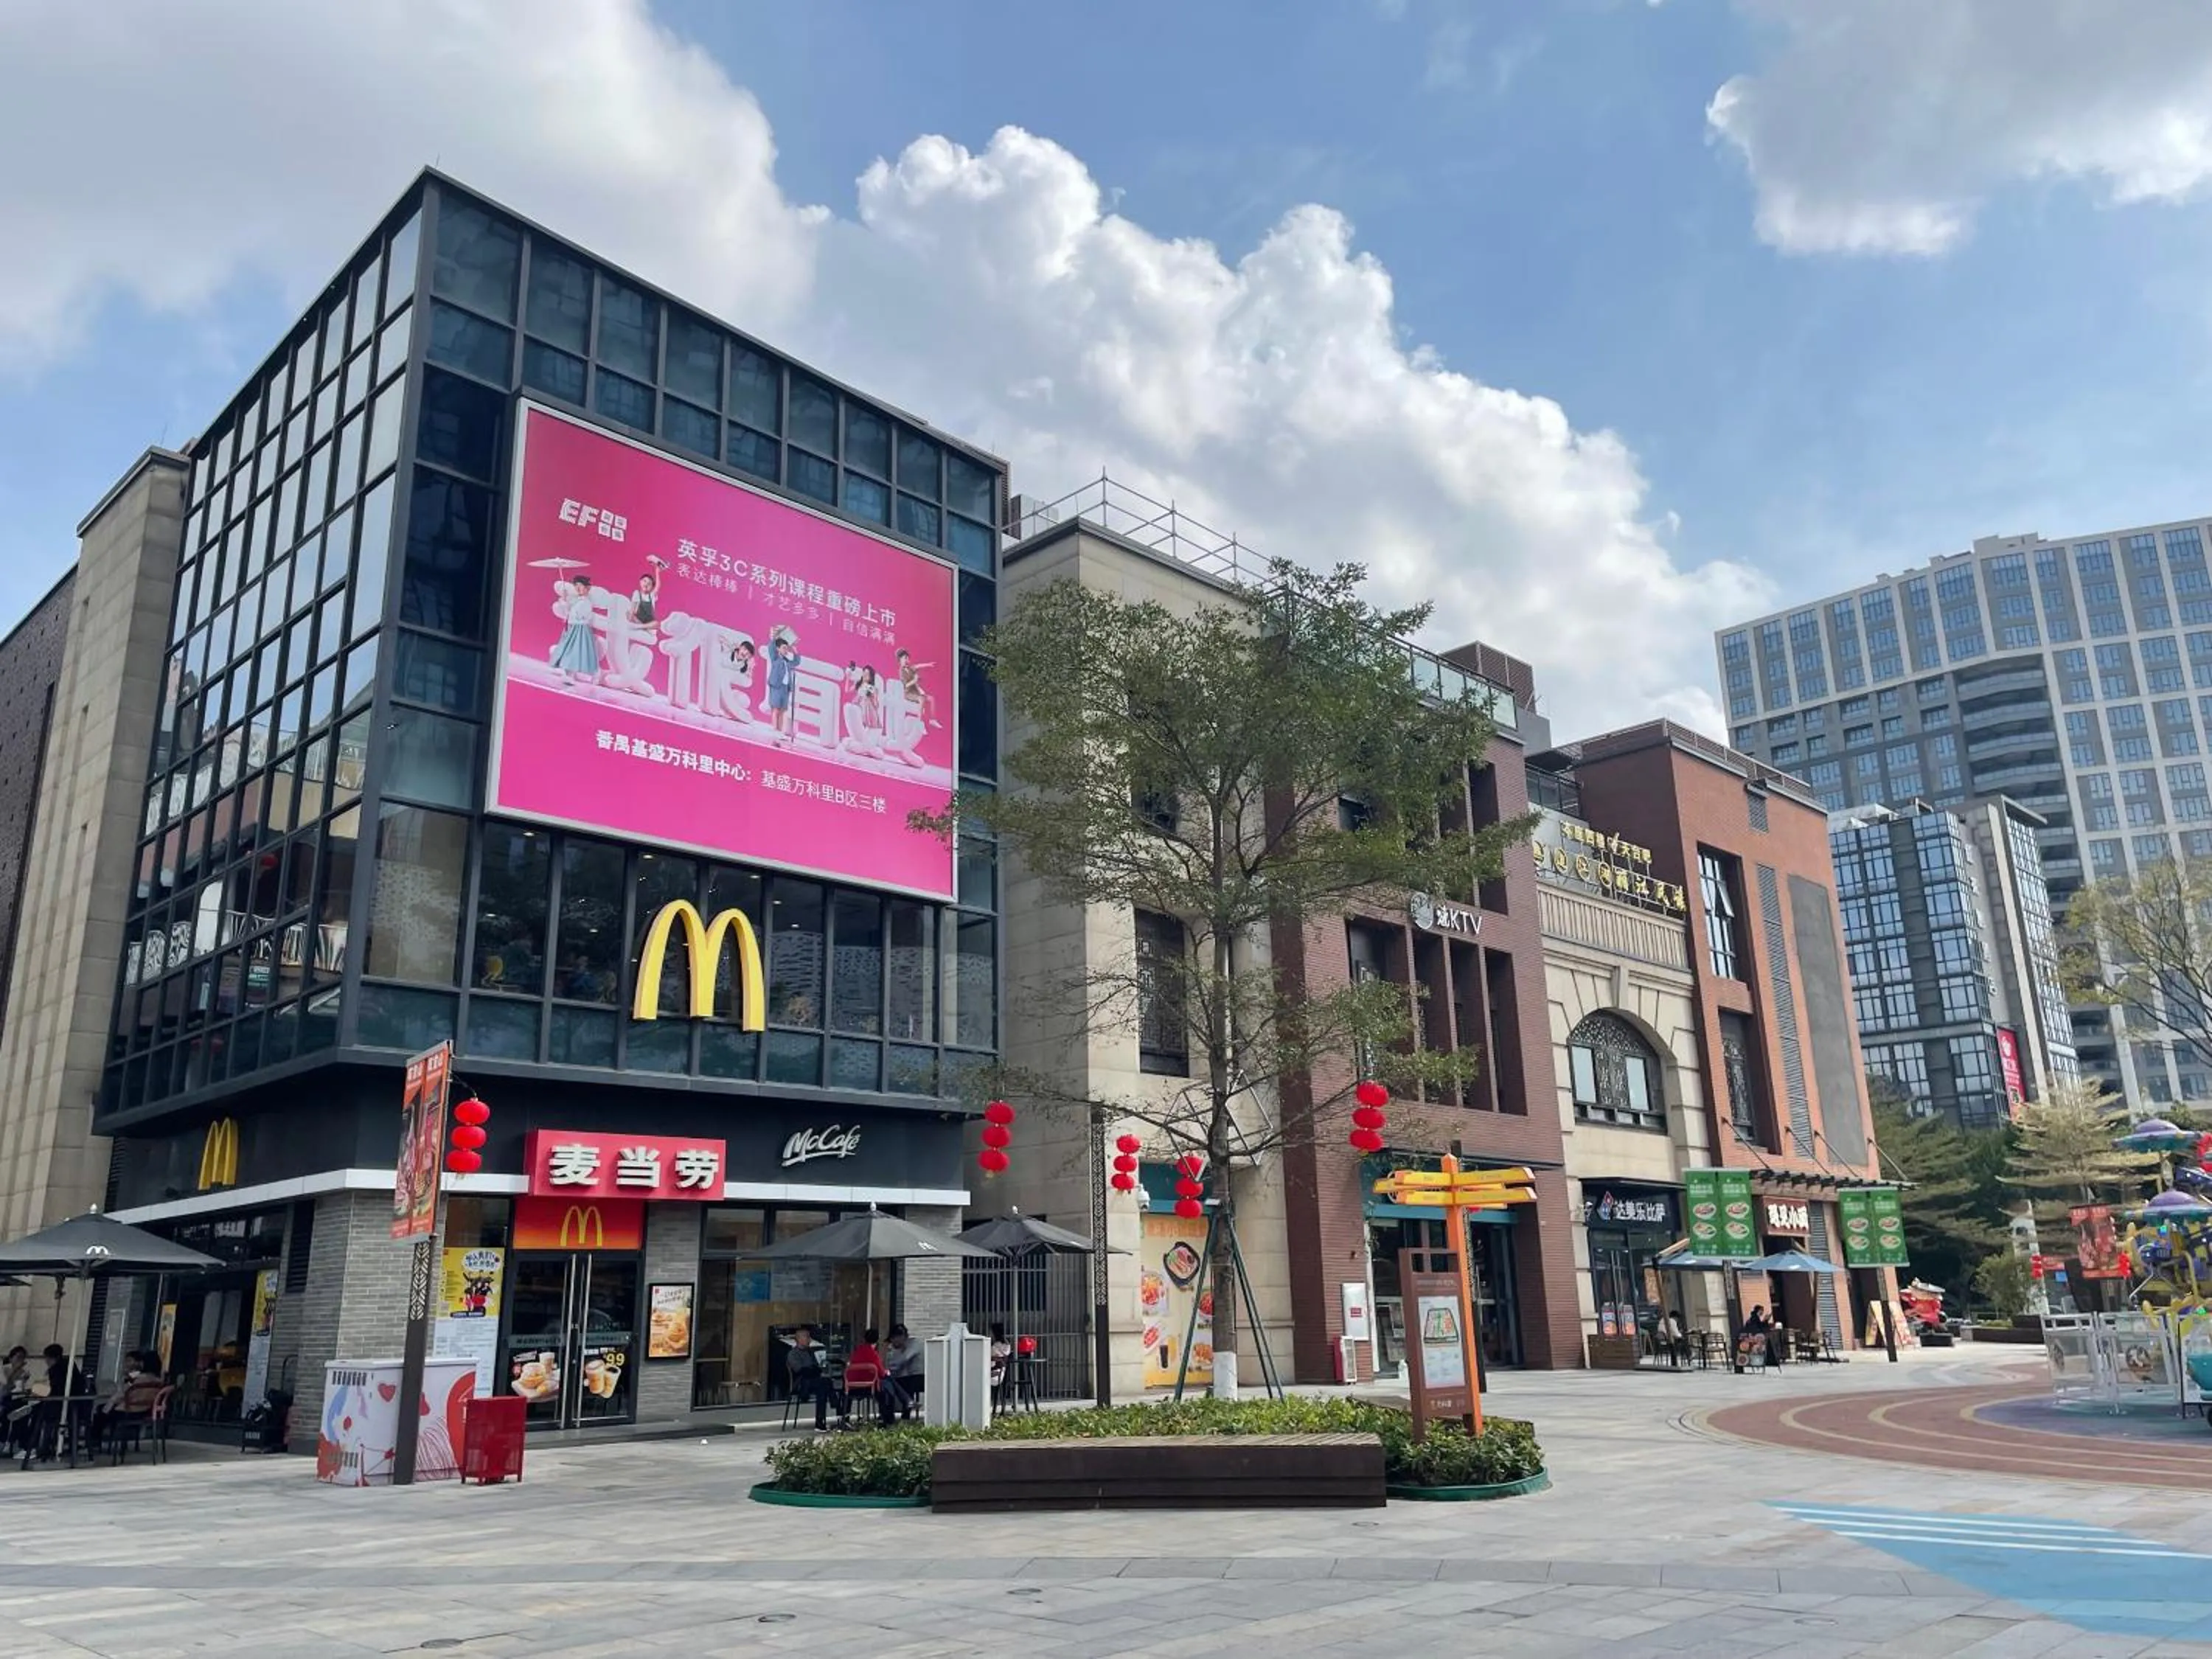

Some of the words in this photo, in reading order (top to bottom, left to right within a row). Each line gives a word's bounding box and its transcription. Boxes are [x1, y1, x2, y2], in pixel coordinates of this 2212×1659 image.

[677, 538, 896, 627] 英孚3C系列课程重磅上市
[549, 1143, 719, 1189] 麦当劳
[782, 1124, 861, 1166] McCafé
[1613, 1200, 1666, 1222] 达美乐比萨
